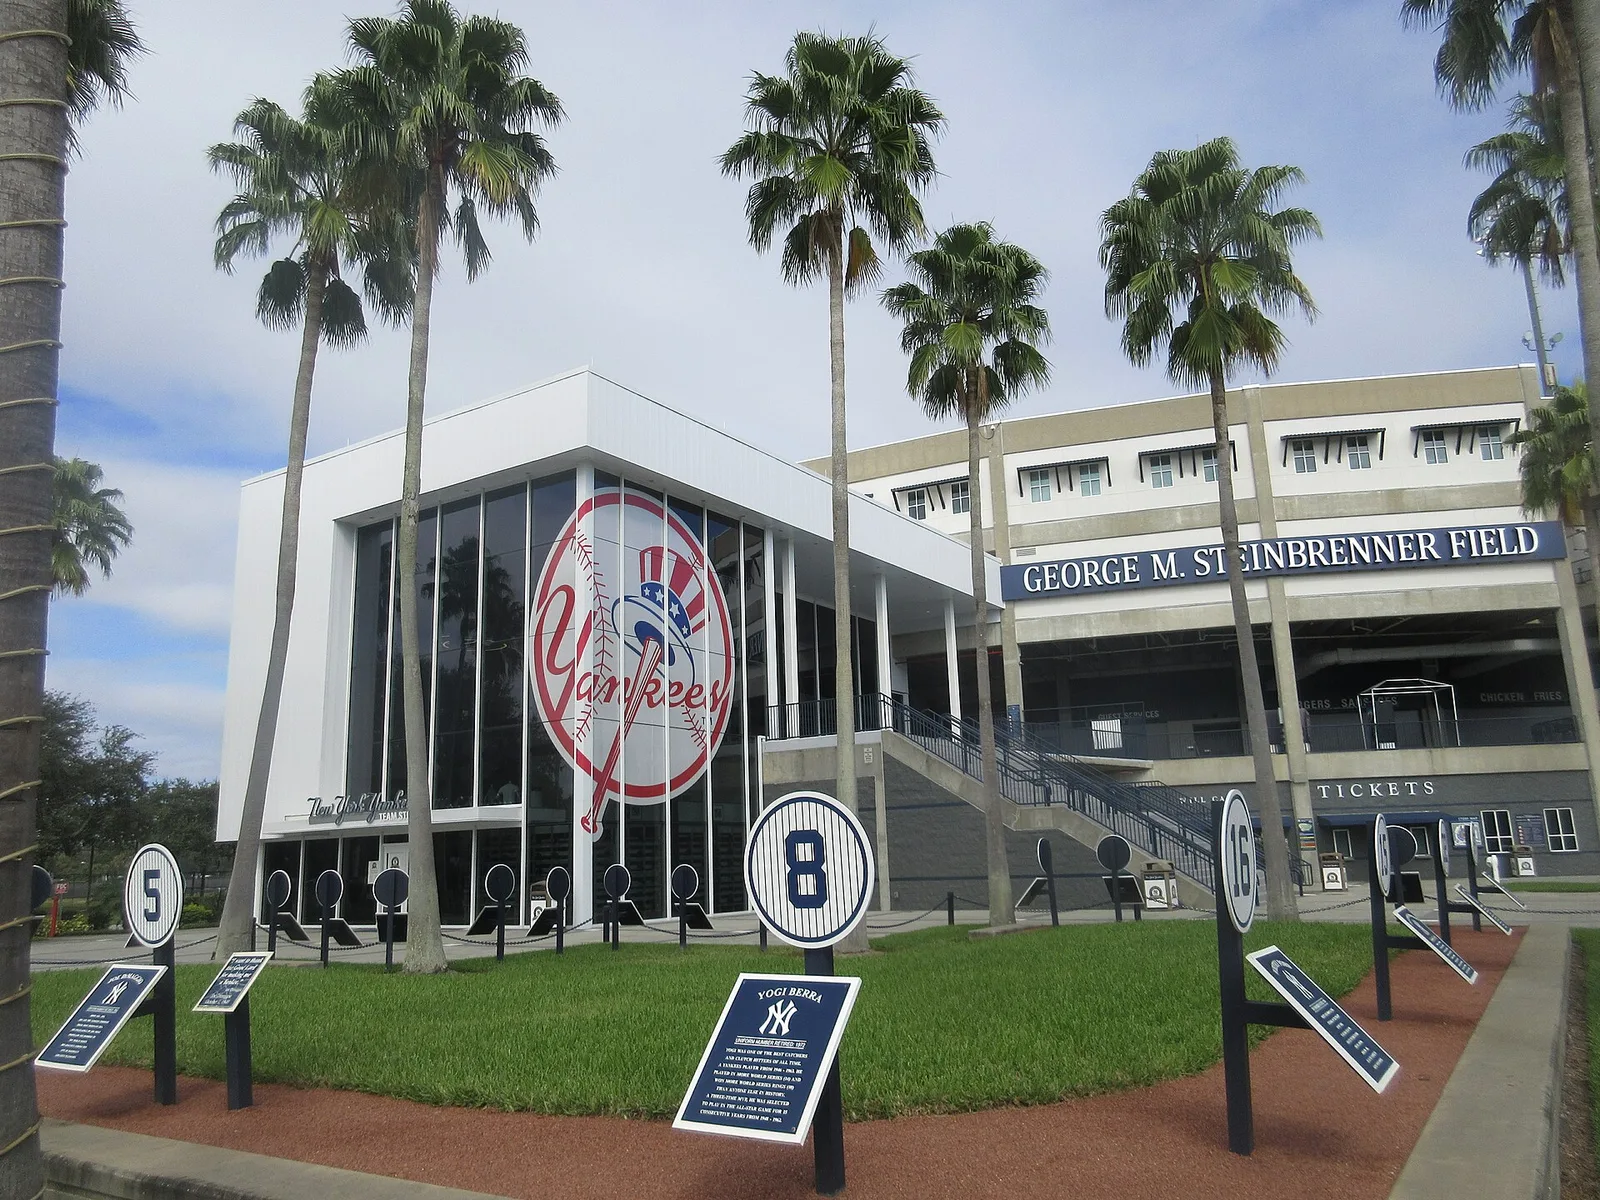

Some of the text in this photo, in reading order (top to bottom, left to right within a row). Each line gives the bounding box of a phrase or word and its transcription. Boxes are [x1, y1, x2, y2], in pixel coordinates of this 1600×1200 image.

[1024, 526, 1539, 593] GEORGE M. STEINBRENNER FIELD
[534, 584, 729, 714] Yankees
[1480, 691, 1562, 702] CHICKEN FRIES
[307, 790, 408, 826] New York Yanke
[1317, 781, 1434, 798] TICKETS
[380, 812, 397, 820] TEAM
[785, 829, 828, 909] 8
[1231, 824, 1251, 898] 16
[144, 870, 161, 922] 5
[758, 987, 822, 1004] YOGI BERRA
